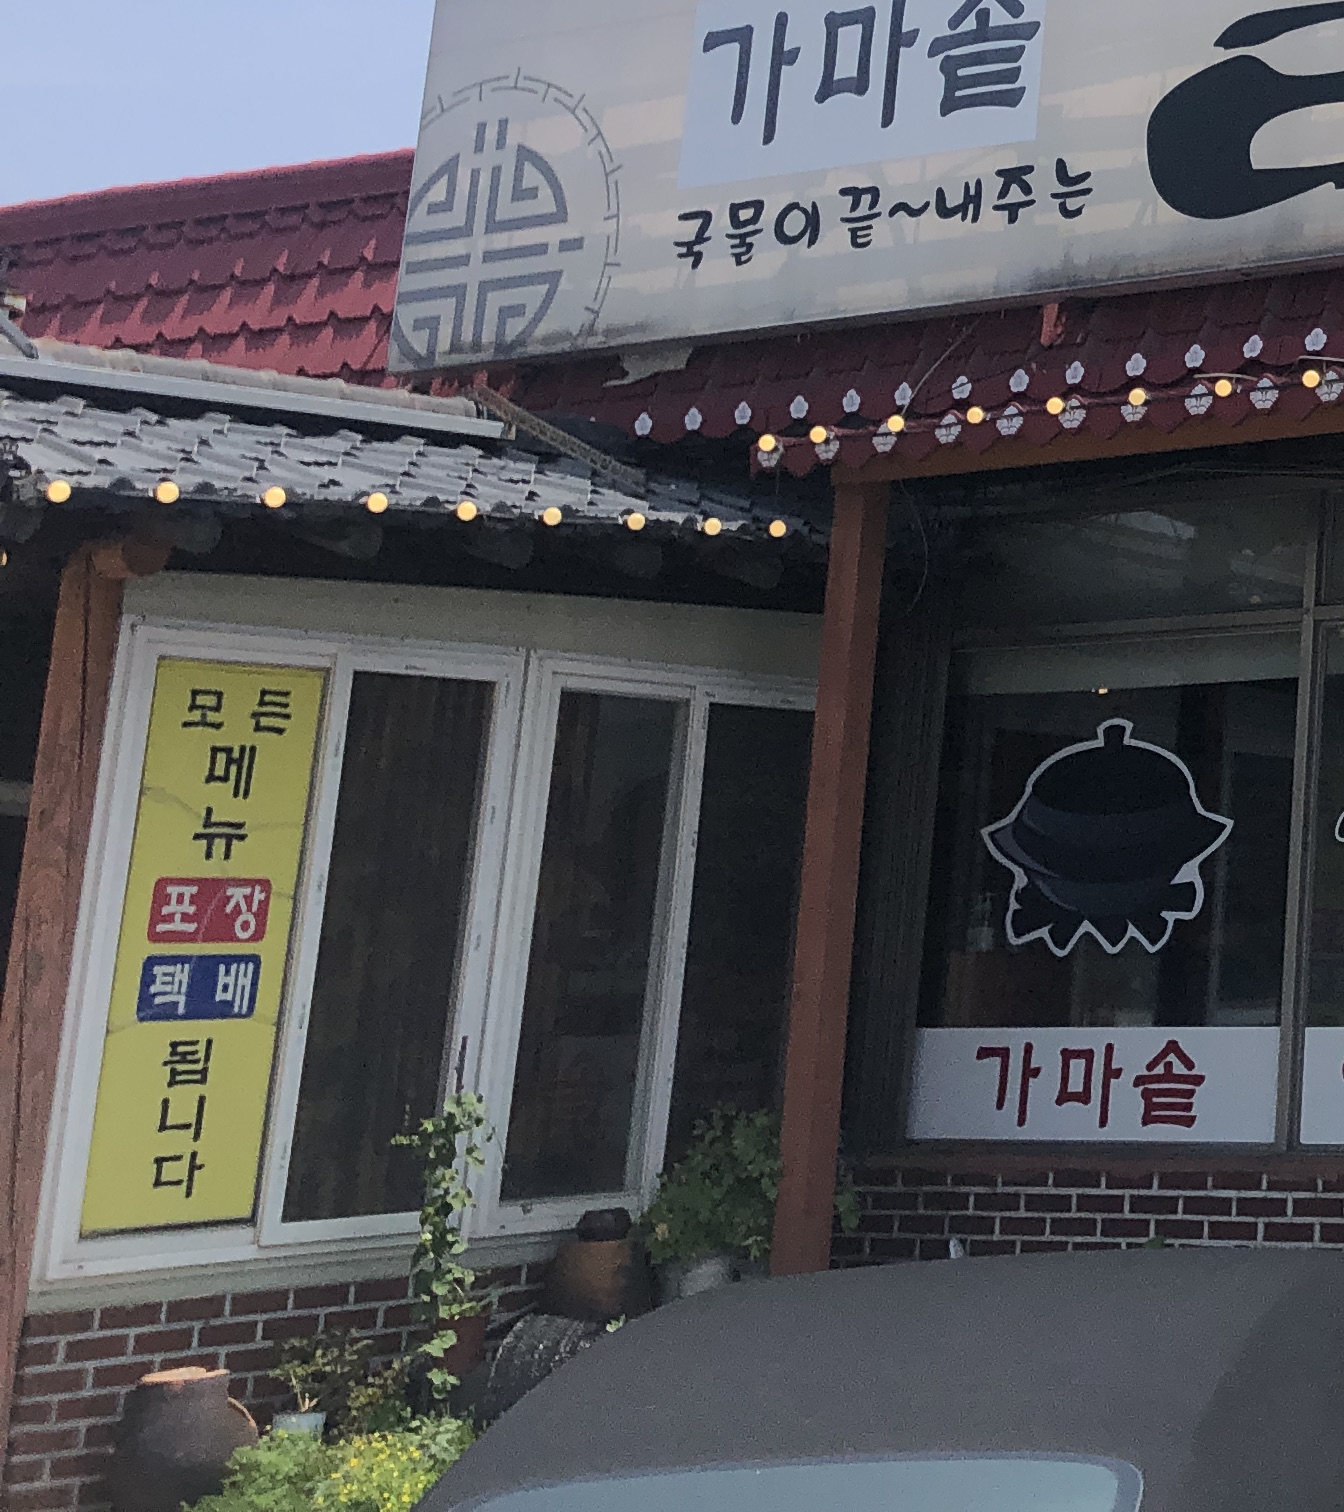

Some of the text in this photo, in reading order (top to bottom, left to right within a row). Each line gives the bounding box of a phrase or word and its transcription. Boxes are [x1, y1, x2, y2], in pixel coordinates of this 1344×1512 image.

[673, 197, 822, 269] 국물이
[180, 688, 292, 736] 모든
[192, 744, 258, 861] 메뉴
[155, 884, 266, 939] 포장
[150, 961, 254, 1015] 택배
[152, 1037, 214, 1199] 됩니다
[975, 1039, 1205, 1129] 가마솥
